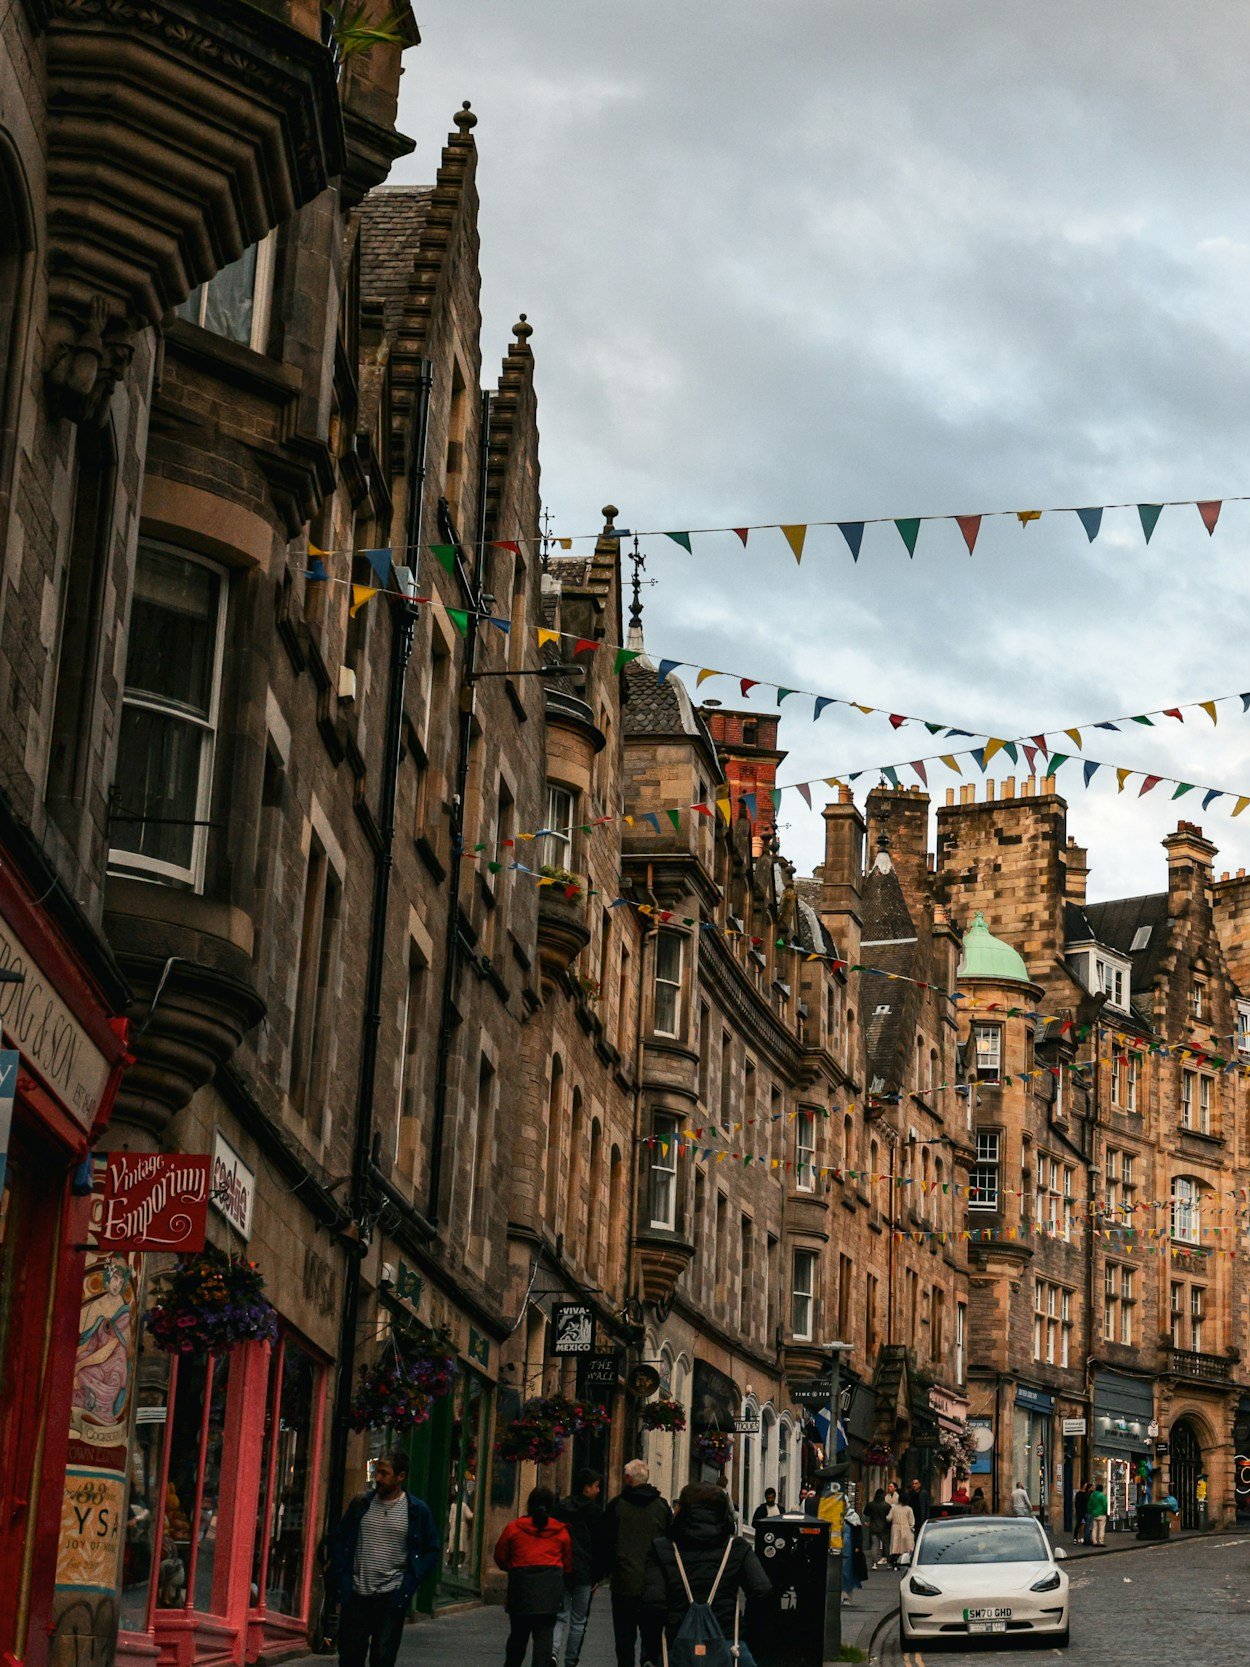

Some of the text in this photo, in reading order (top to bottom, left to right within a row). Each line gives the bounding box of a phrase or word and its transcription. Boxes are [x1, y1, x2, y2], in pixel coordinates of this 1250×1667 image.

[43, 1015, 82, 1092] SON
[110, 1155, 164, 1194] Vintage
[104, 1163, 207, 1243] Emporium
[556, 1343, 591, 1352] MEXICO
[590, 1360, 613, 1370] THE
[66, 1540, 86, 1550] JOY
[90, 1542, 101, 1552] OF
[970, 1608, 1012, 1618] SM70 GHD
